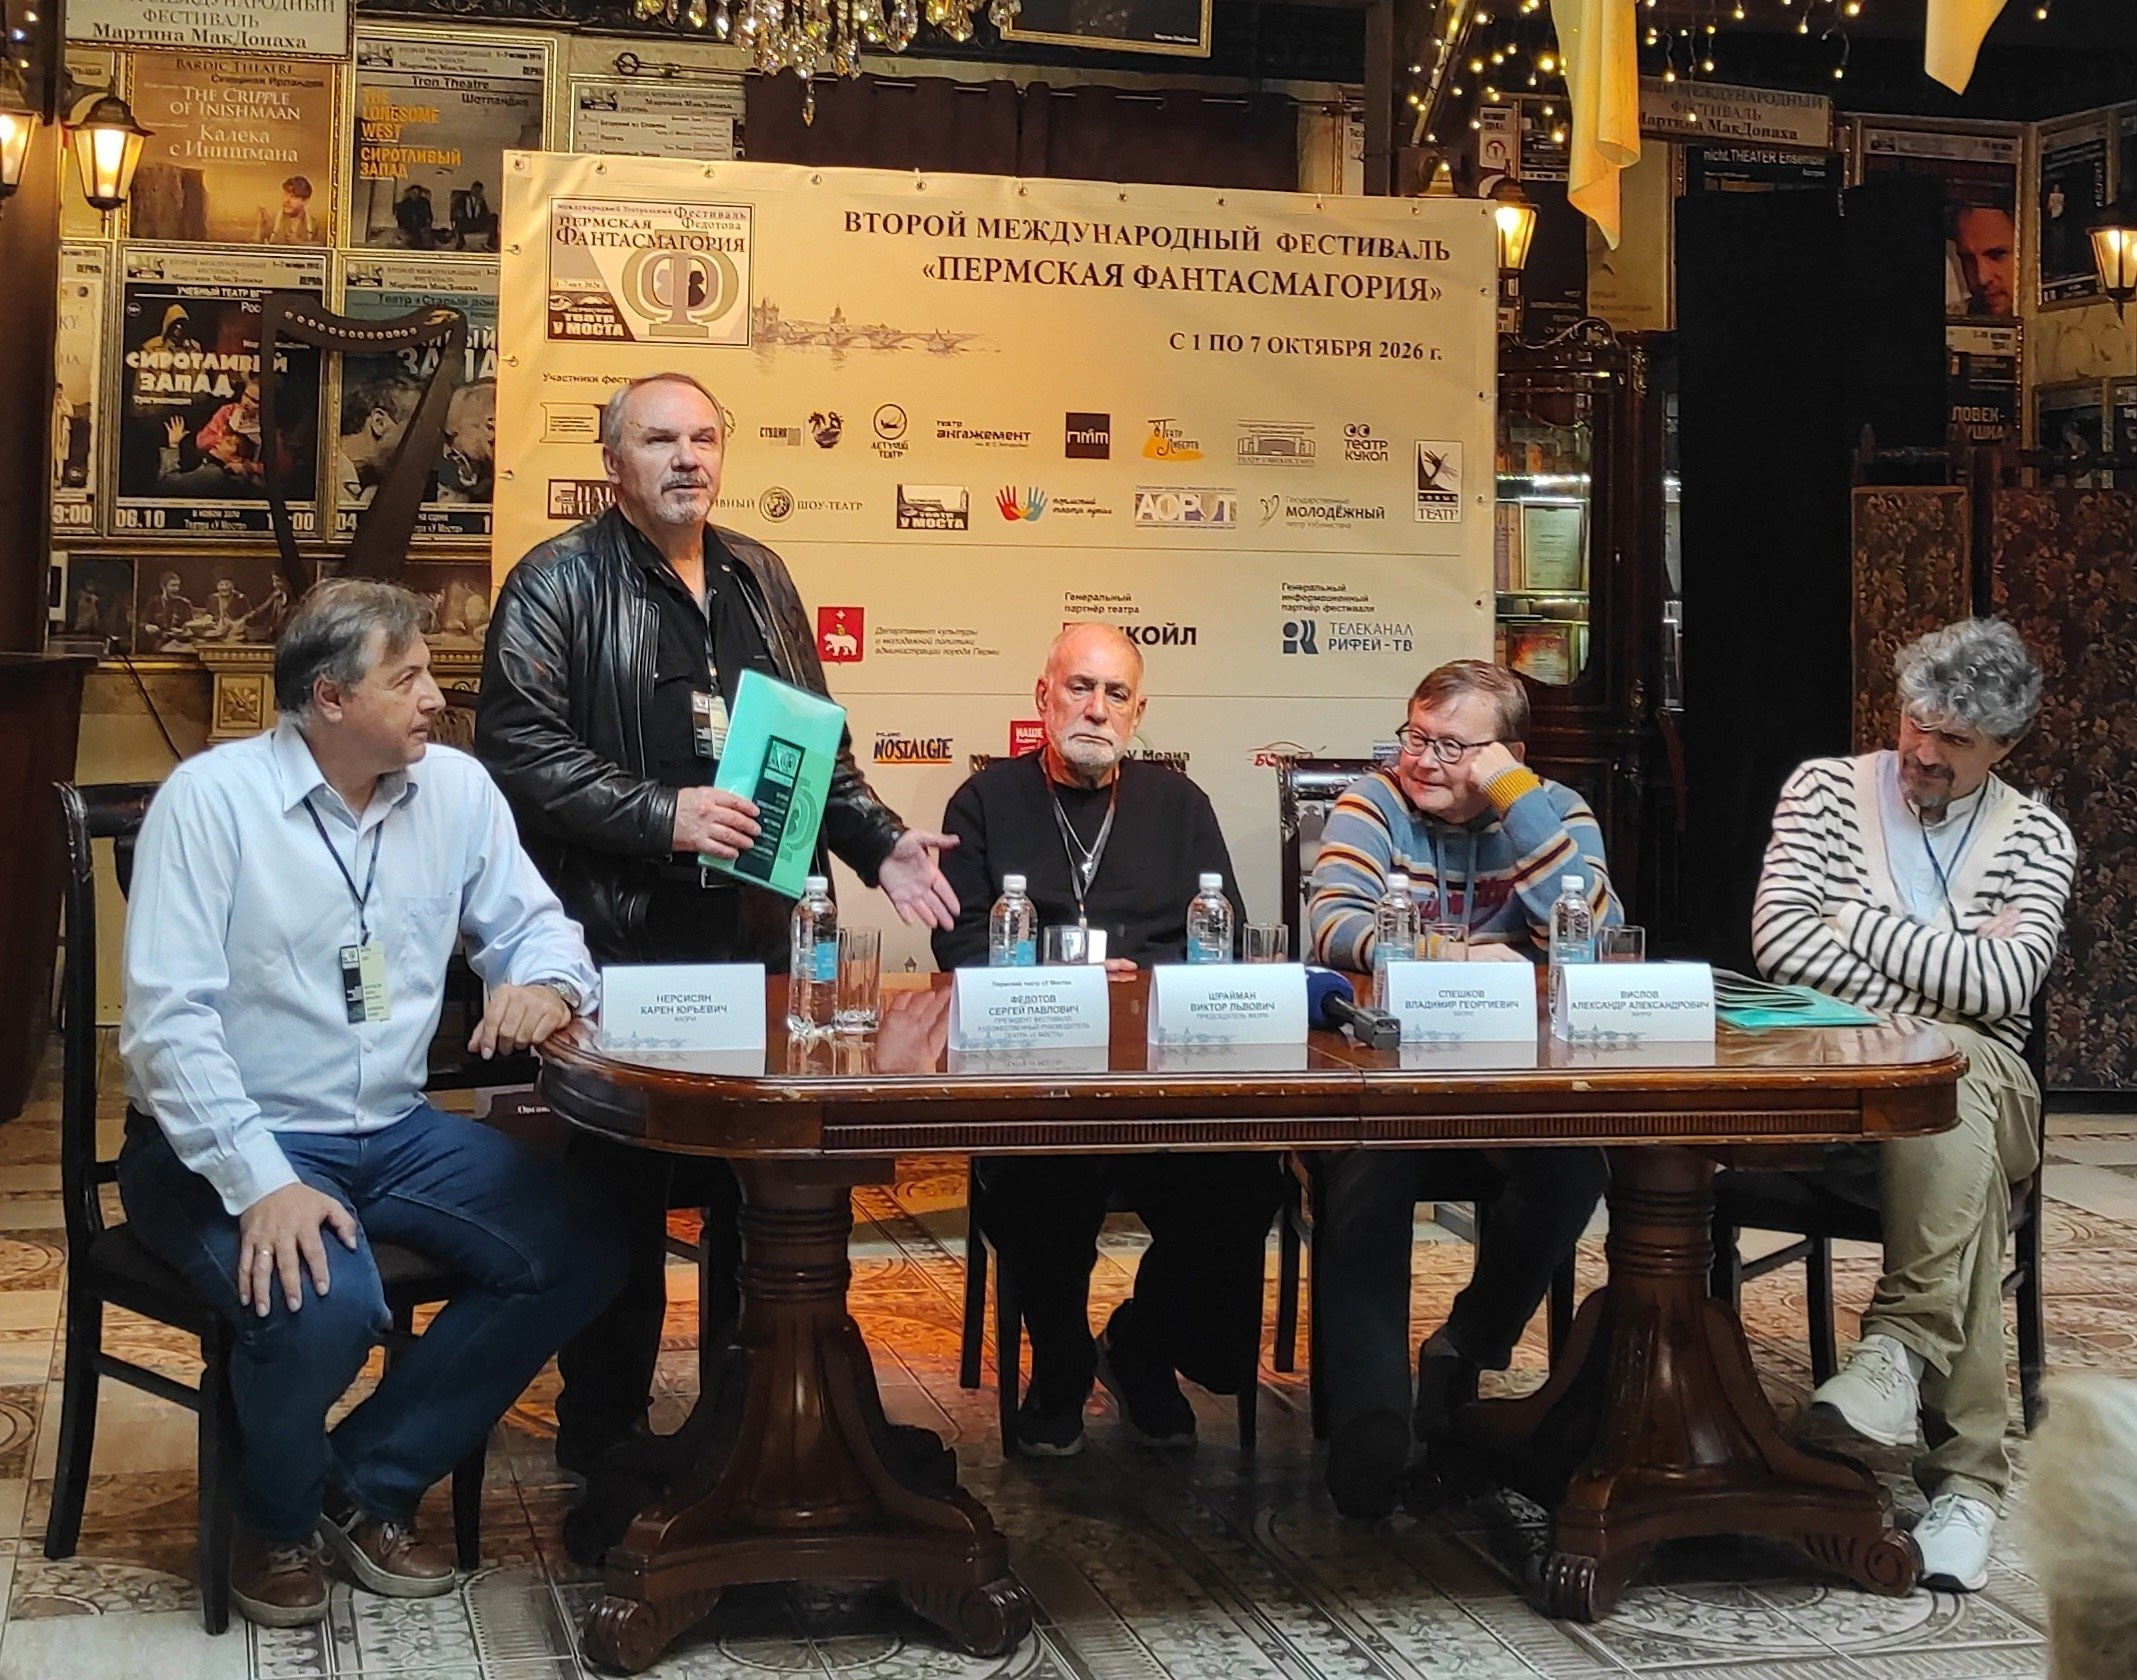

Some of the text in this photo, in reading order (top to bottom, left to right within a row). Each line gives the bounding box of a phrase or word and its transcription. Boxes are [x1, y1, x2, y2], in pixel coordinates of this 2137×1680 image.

[143, 9, 259, 28] ФЕСТИВАЛЬ
[93, 22, 306, 49] Мартина МакДонаха
[412, 75, 490, 90] Tron Theatre
[182, 86, 291, 106] THE CRIPPLE
[169, 101, 301, 121] OF INISHMAAN
[362, 105, 440, 124] LONESOME
[1671, 101, 1762, 121] ФЕСТИВАЛЬ
[200, 124, 270, 144] Калека
[361, 121, 403, 139] WEST
[1708, 118, 1798, 141] МакДонаха
[361, 146, 462, 167] СИРОТЛИВЫЙ
[360, 161, 408, 180] ЗАПАД
[674, 206, 747, 220] Фестиваль
[559, 215, 653, 230] ПЕРМСКАЯ
[682, 217, 742, 231] Федотова
[844, 210, 1451, 262] ВТОРОЙ МЕЖДУНАРОДНЫЙ ФЕСТИВАЛЬ
[922, 255, 1442, 302] «ПЕРМСКАЯ ФАНТАСМАГОРИЯ»
[552, 321, 625, 337] У МОСТА
[1169, 332, 1443, 361] С 1 ПО 7 ОКТЯБРЯ 2026 г.
[139, 372, 235, 399] ЗАПАД
[1952, 405, 2005, 422] ЛОВЕК-
[936, 429, 1032, 442] ангажемент
[715, 499, 863, 512] ВНЫЙ ШОУ-ТЕАТР
[1285, 504, 1385, 521] МОЛОДЁЖНЫЙ
[52, 504, 92, 524] 9:00
[115, 508, 166, 529] 06.10
[265, 512, 314, 531] 1:00
[1418, 508, 1459, 520] ТЕАТР
[900, 516, 965, 529] У МОСТА
[1282, 582, 1347, 592] Генеральный
[1064, 591, 1132, 603] Генеральный
[1064, 605, 1140, 615] партнёр театра
[1322, 605, 1375, 613] фестиваля
[1118, 622, 1197, 646] КОЙЛ
[1329, 622, 1414, 637] ТЕЛЕКАНАЛ
[873, 737, 954, 760] NOSTALGIE
[656, 993, 712, 1003] НЕРСИСЯН
[1010, 994, 1057, 1005] ФЕДОТОВ
[1208, 990, 1257, 1001] ШРАЙМАН
[1438, 989, 1485, 998] СПЕШКОВ
[1620, 990, 1660, 999] ВИСЛОВ
[640, 1004, 728, 1015] КАРЕН ЮРЬЕВИЧ
[988, 1004, 1079, 1016] СЕРГЕЙ ПАВЛОВИЧ
[1190, 1002, 1275, 1012] ВИКТОР ЛЬВОВИЧ
[1405, 1000, 1520, 1009] ВЛАДИМИР ГЕОРГИЕВИЧ
[1570, 1000, 1710, 1011] АЛЕКСАНДР АЛЕКСАНДРОВИЧ
